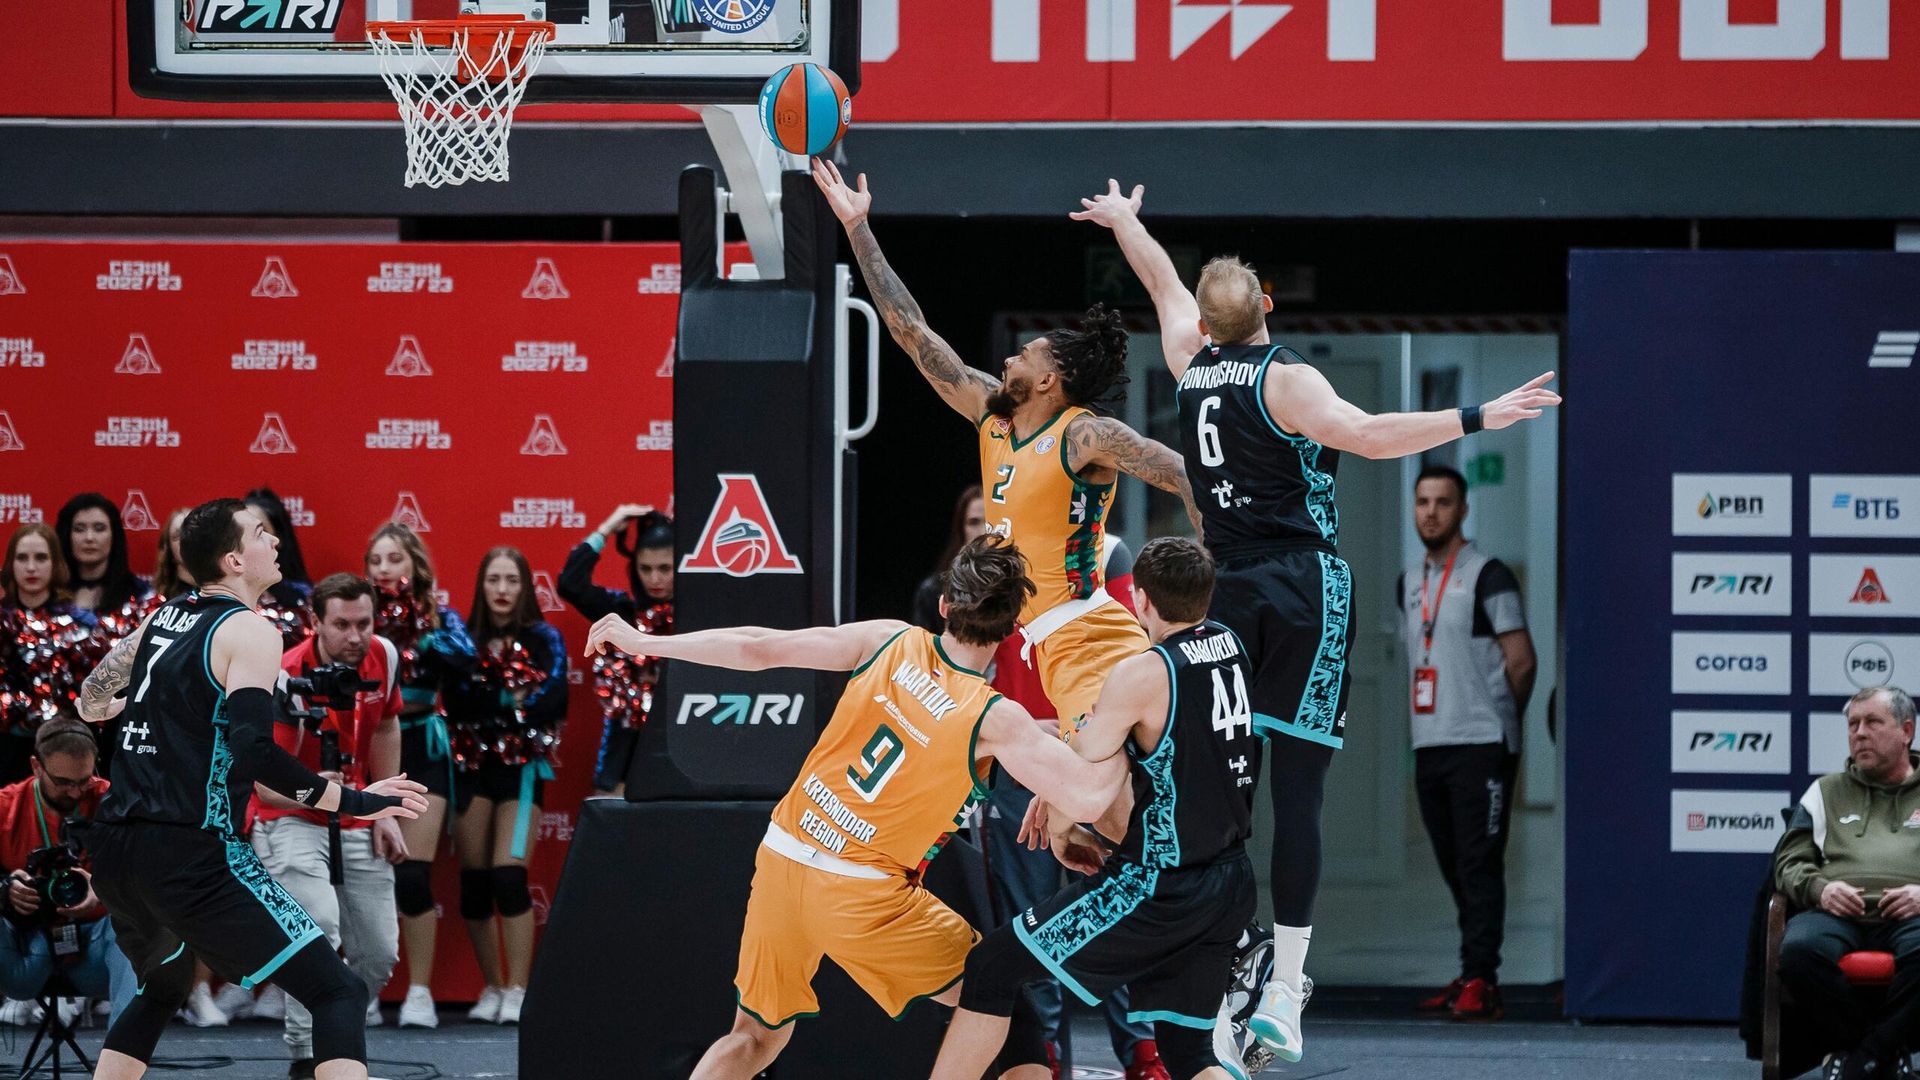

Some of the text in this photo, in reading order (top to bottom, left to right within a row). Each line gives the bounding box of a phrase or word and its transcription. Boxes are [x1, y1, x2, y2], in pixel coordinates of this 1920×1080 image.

[700, 6, 713, 21] VTB
[712, 19, 742, 31] UNITED
[743, 4, 771, 29] LEAGUE
[96, 275, 182, 291] 2022/23
[367, 276, 453, 293] 2022/23
[231, 354, 317, 370] 2022/23
[501, 355, 588, 372] 2022/23
[1179, 360, 1262, 392] PONKRASHOV
[95, 431, 180, 447] 2022/23
[365, 433, 451, 449] 2022/23
[1198, 396, 1225, 467] 6
[992, 464, 1016, 504] 2
[1719, 496, 1763, 514] РВП
[1855, 499, 1900, 520] ВТБ
[500, 512, 586, 528] 2022/23
[134, 635, 174, 702] 7
[1851, 658, 1887, 672] РФБ
[891, 660, 957, 721] MARTIUK
[1211, 663, 1251, 741] 44
[847, 723, 906, 803] 9
[802, 772, 877, 844] KRASNODAR
[1706, 811, 1775, 830] ЛУКОЙЛ
[799, 809, 849, 854] REGION
